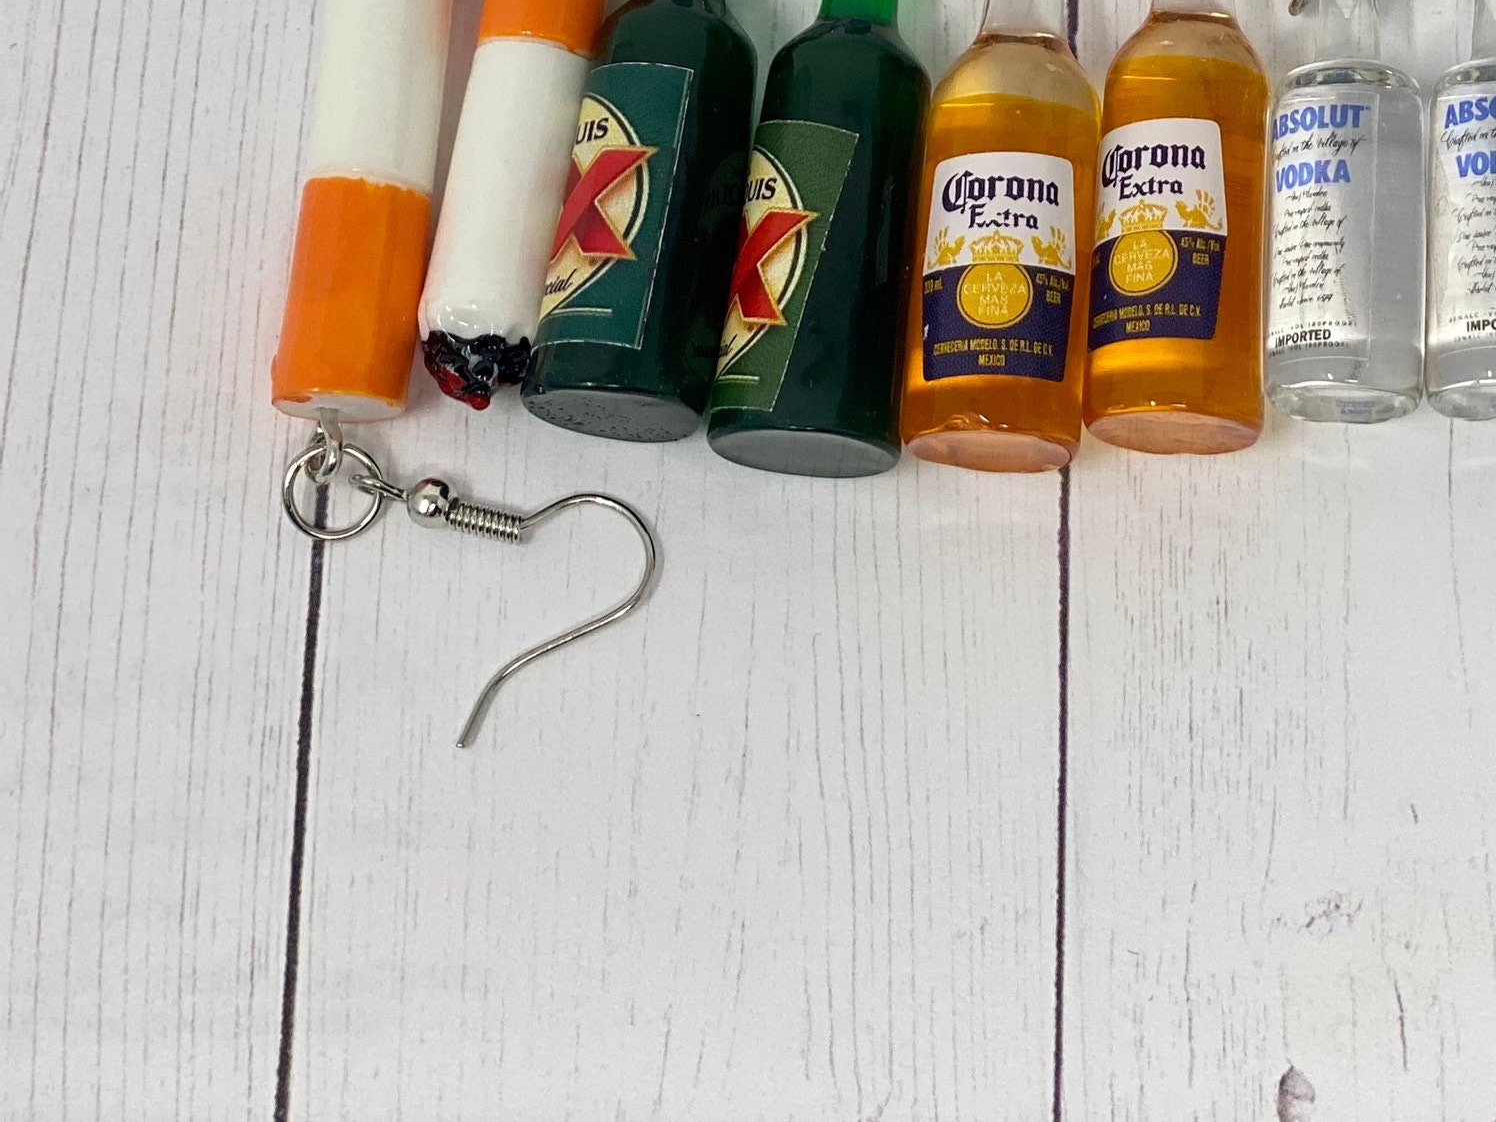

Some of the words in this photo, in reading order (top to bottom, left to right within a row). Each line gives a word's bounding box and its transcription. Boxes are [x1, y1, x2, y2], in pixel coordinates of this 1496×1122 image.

[1273, 104, 1364, 141] ABSOLUT
[1102, 144, 1206, 188] Corona
[1276, 159, 1351, 193] VODKA
[745, 178, 778, 203] UIS
[942, 170, 1060, 214] Corona
[1119, 174, 1183, 200] Extra
[968, 203, 1039, 230] Extra
[1275, 328, 1331, 349] IMPORTED
